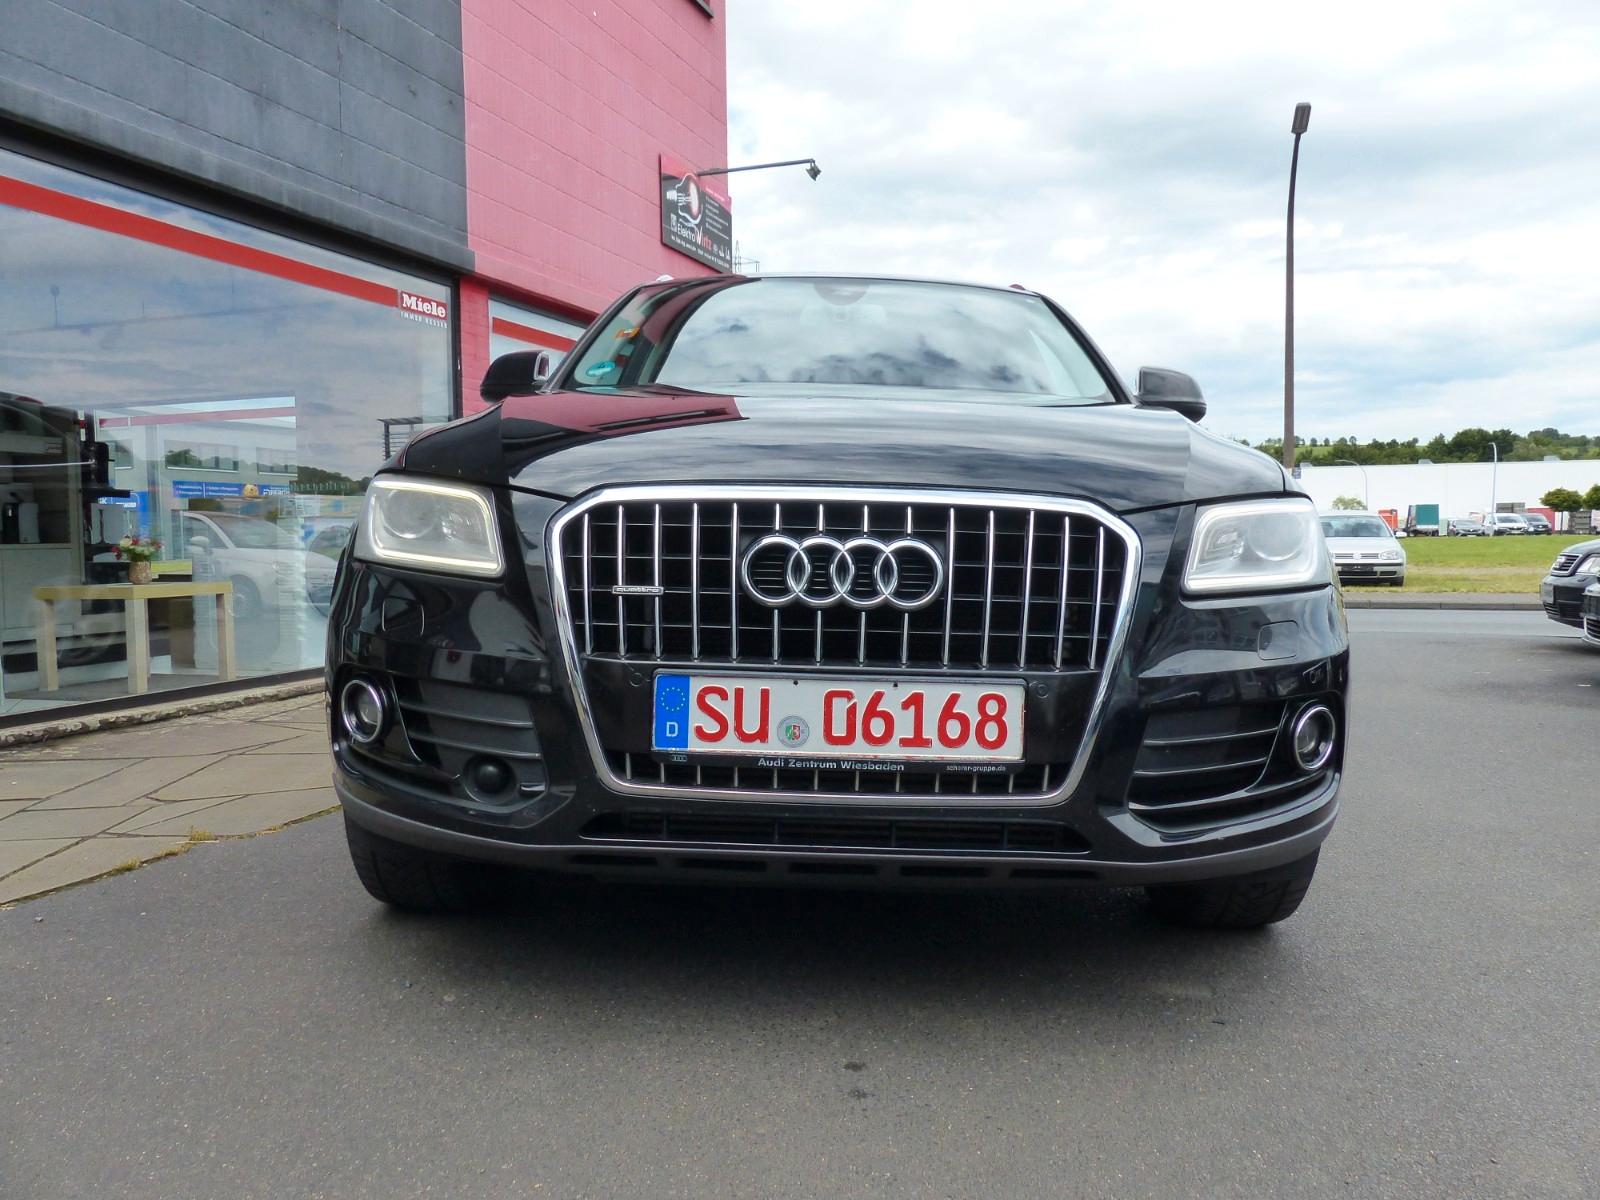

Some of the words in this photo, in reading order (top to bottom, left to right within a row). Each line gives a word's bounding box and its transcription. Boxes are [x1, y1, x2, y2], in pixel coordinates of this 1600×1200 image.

[678, 223, 696, 242] Elektro
[402, 293, 446, 318] Miele
[694, 685, 770, 744] SU
[823, 688, 1009, 750] 06168
[666, 721, 679, 737] D
[758, 757, 785, 768] Audi
[788, 758, 837, 769] Zentrum
[840, 760, 905, 771] Wiesbaden
